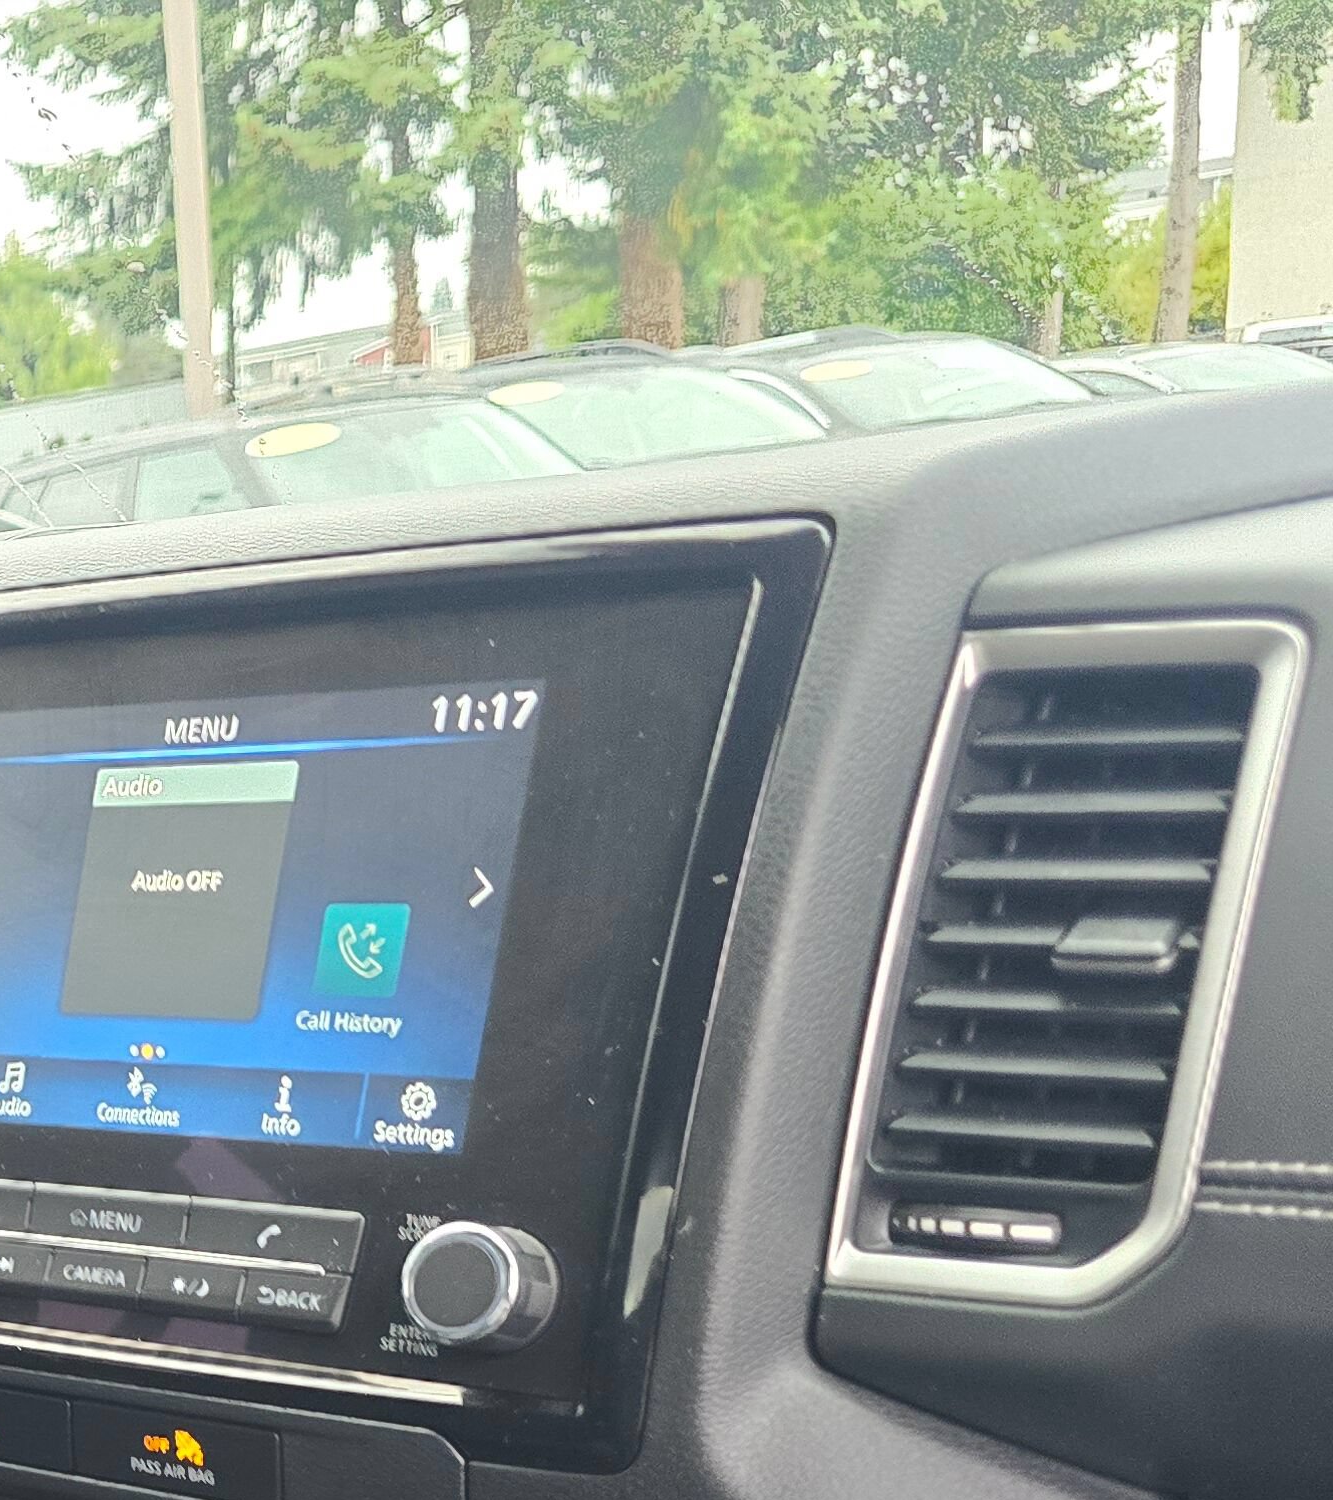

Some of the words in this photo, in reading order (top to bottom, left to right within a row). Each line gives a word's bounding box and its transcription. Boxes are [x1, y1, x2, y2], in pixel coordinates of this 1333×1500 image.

[433, 690, 538, 733] 11:17
[163, 715, 239, 745] MENU
[102, 774, 164, 798] Audio
[131, 870, 183, 892] Audio
[186, 870, 223, 892] OFF
[296, 1010, 330, 1031] Call
[334, 1013, 402, 1039] History
[96, 1102, 181, 1127] Connections
[261, 1112, 302, 1137] Info
[373, 1120, 455, 1151] Settings
[89, 1208, 143, 1234] MENU
[62, 1263, 126, 1289] CAMERA
[275, 1287, 322, 1313] BACK
[379, 1335, 439, 1358] SETTING
[130, 1456, 162, 1477] PASS
[164, 1462, 186, 1481] AIR
[188, 1466, 216, 1487] BAG
